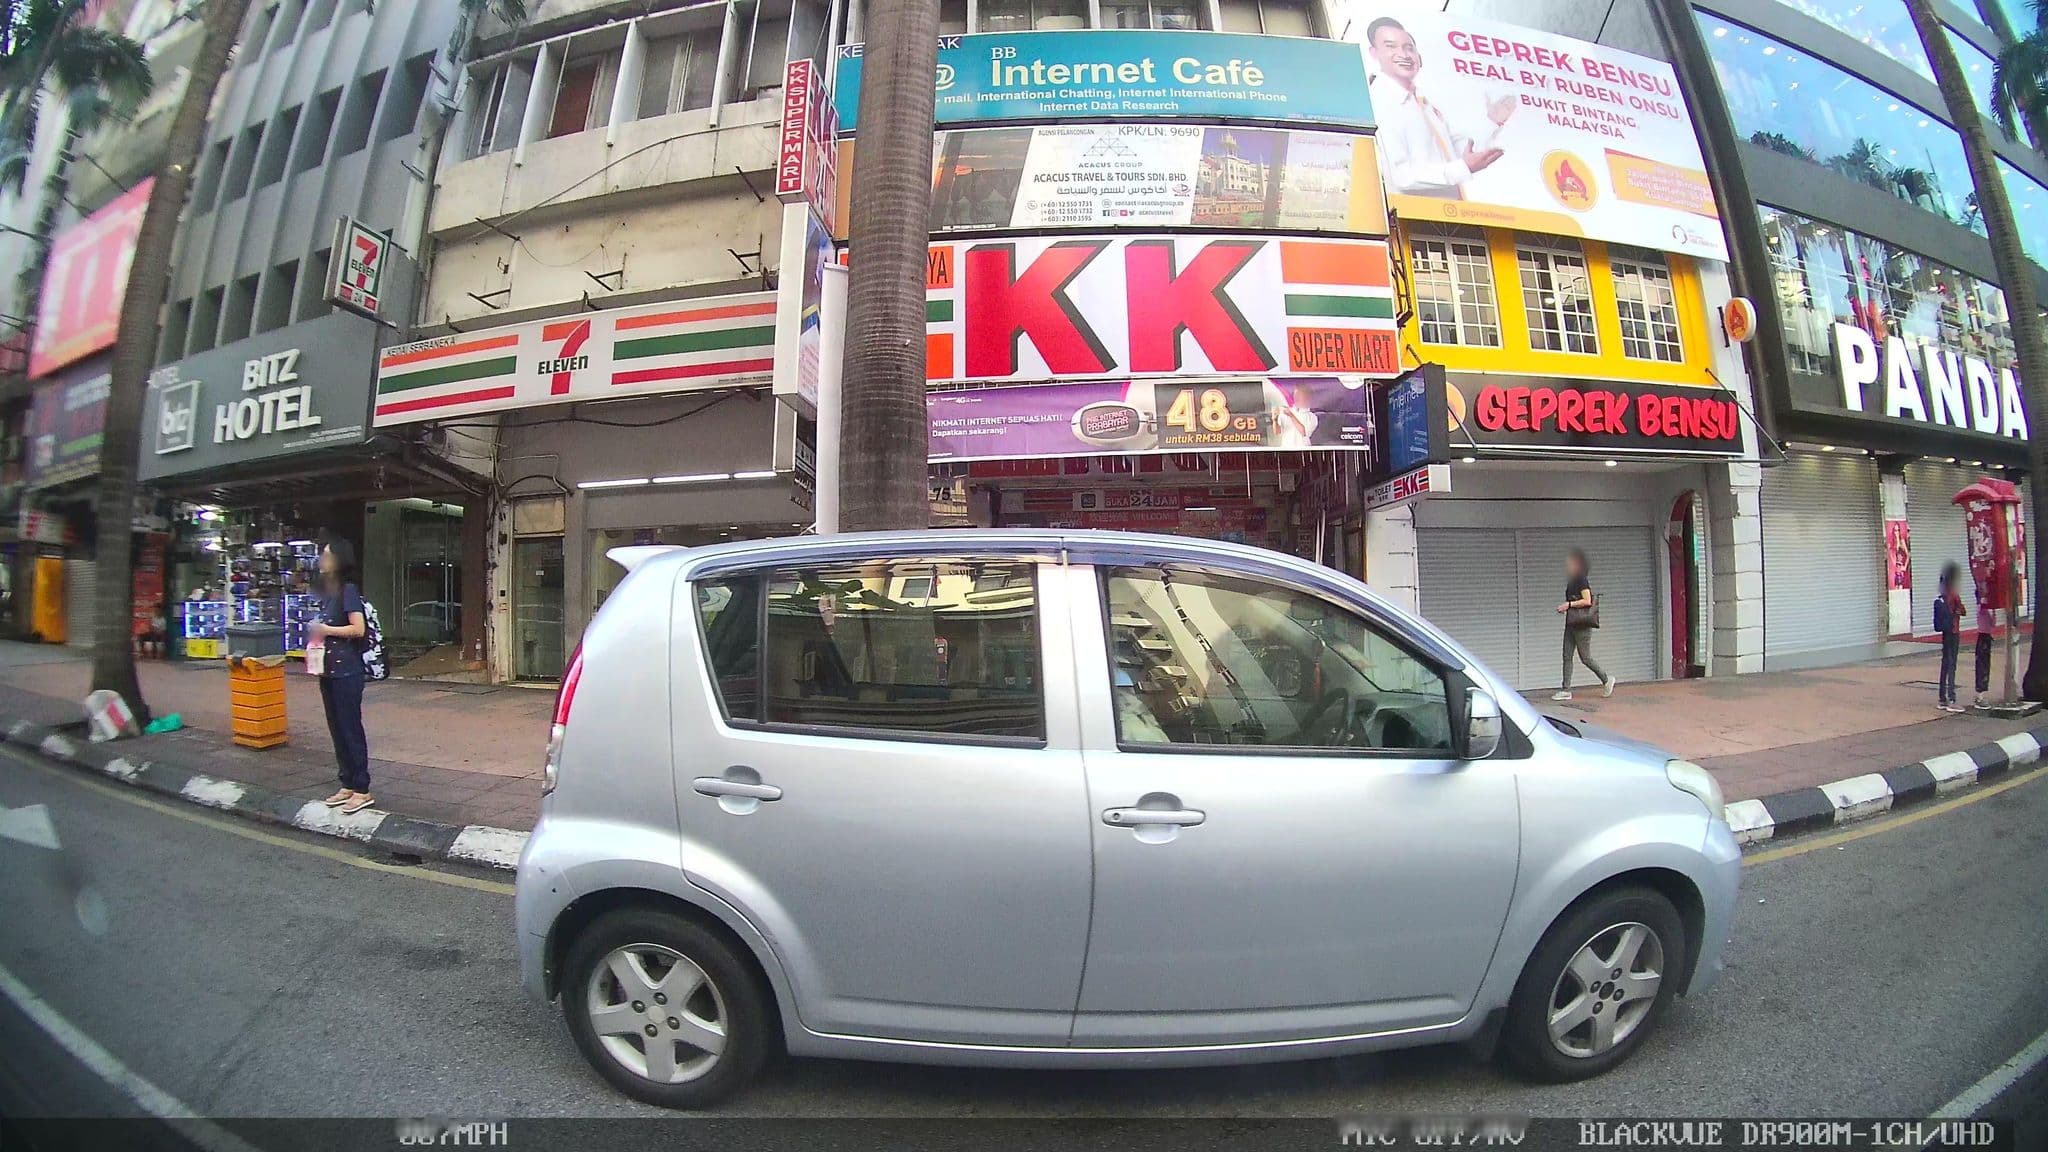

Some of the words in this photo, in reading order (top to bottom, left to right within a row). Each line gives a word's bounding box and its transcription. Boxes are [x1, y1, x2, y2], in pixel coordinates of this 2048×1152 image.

[991, 46, 1017, 60] BB
[1447, 30, 1575, 73] GEPREK
[1581, 57, 1672, 97] BENSU
[991, 57, 1157, 87] Internet
[1172, 57, 1265, 87] Café
[977, 88, 1056, 102] International
[1059, 88, 1116, 101] Chatting,
[1118, 88, 1166, 98] Internet
[1170, 88, 1246, 99] International
[1249, 90, 1287, 102] Phone
[1452, 58, 1514, 82] REAL
[1519, 70, 1547, 88] BY
[1554, 77, 1625, 106] RUBEN
[1629, 95, 1681, 120] ONSU
[1039, 102, 1088, 112] Internet
[1091, 101, 1119, 111] Data
[1122, 101, 1179, 110] Research
[1520, 94, 1567, 113] BUKIT
[1170, 128, 1200, 137] 9690
[1547, 113, 1625, 139] MALAYSIA
[1033, 173, 1070, 183] ACACUS
[1071, 172, 1106, 182] TRAVEL
[1107, 173, 1114, 181] &
[1115, 172, 1146, 181] TOURS
[966, 240, 1278, 378] KK
[542, 318, 591, 396] 7
[1293, 332, 1344, 369] SUPER
[1351, 334, 1392, 369] MART
[242, 348, 301, 391] BITZ
[537, 354, 589, 375] ELEVEN
[1833, 321, 2030, 441] PANDA
[213, 385, 322, 444] HOTEL
[932, 417, 966, 428] NIKMATI
[966, 416, 1007, 426] INTERNET
[1007, 414, 1039, 424] SEPUAS
[1166, 388, 1232, 433] 48
[1233, 416, 1257, 431] GB
[1476, 384, 1630, 435] GEPREK
[1637, 392, 1738, 441] BENSU
[932, 427, 967, 438] Dapatkan
[968, 425, 1007, 435] sekarang!
[1165, 434, 1194, 444] untuk
[1195, 433, 1222, 443] RM38
[1222, 432, 1261, 443] sebulan
[1402, 472, 1419, 497] KK
